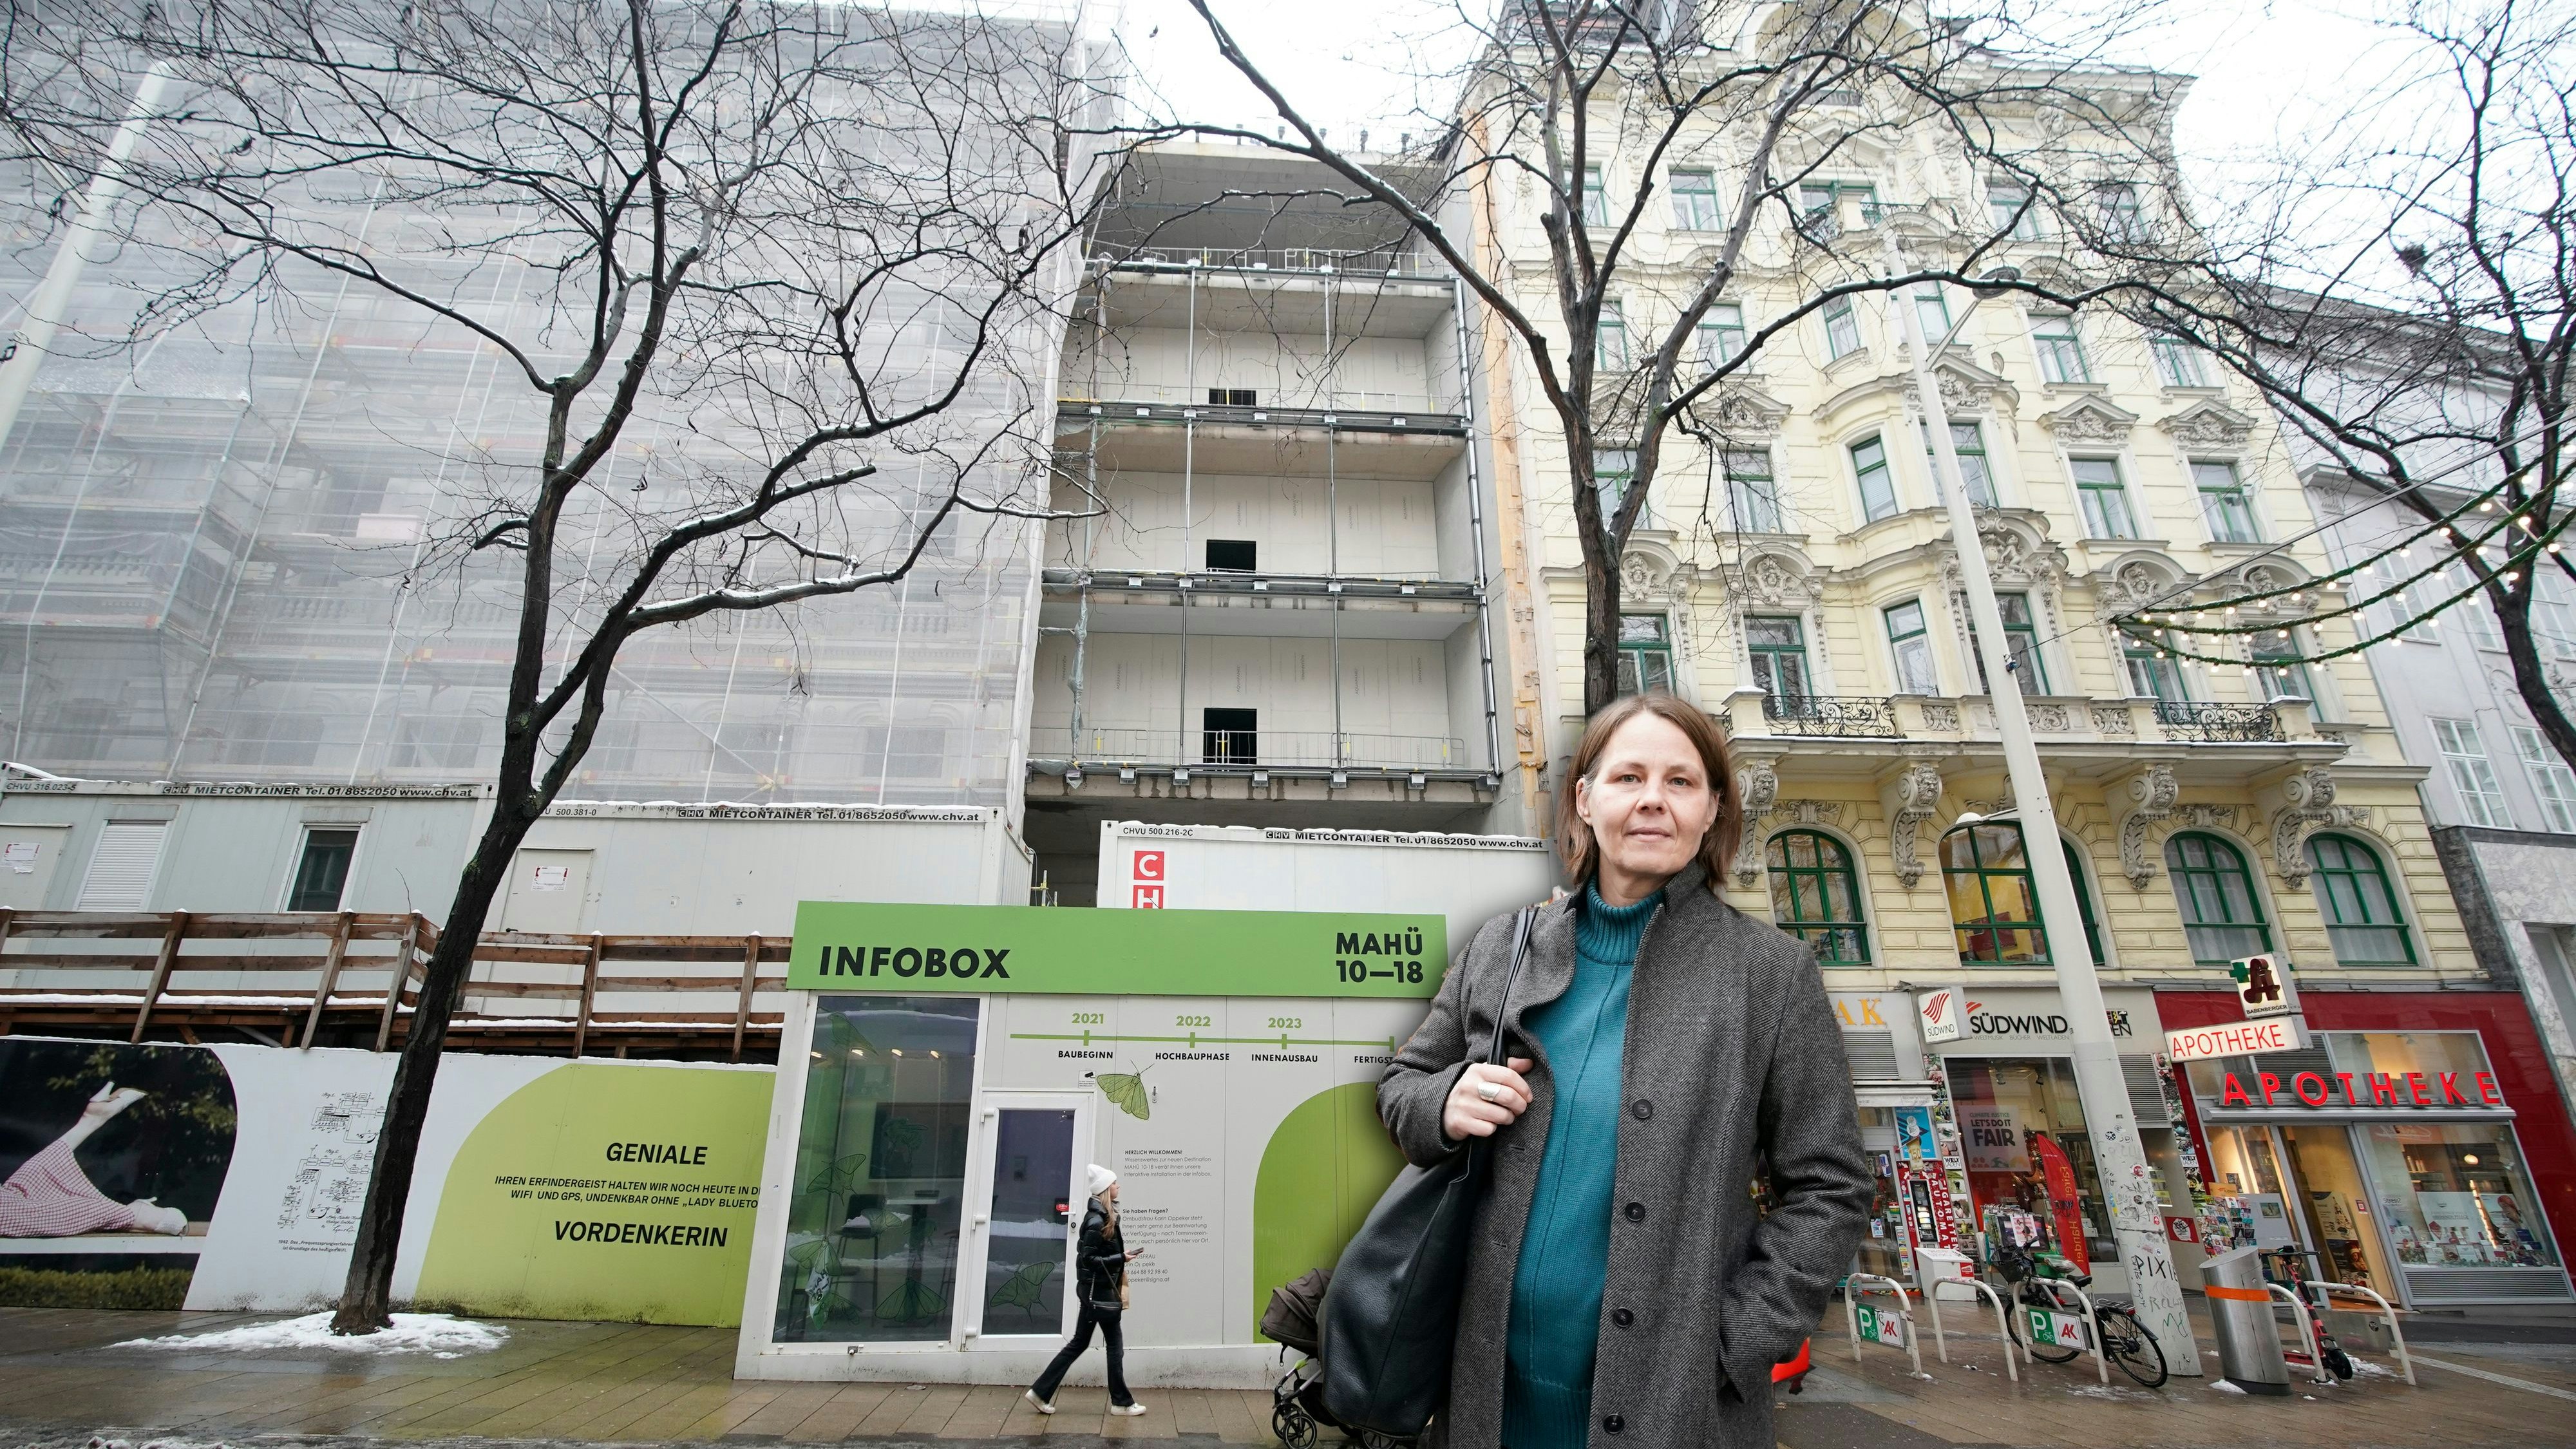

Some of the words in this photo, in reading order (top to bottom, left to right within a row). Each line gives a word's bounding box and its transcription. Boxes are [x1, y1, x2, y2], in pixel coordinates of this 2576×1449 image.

[194, 786, 300, 795] MIETCONTAINER
[305, 787, 325, 795] Tel.
[327, 787, 397, 796] 01/8652050
[399, 788, 473, 797] www.chv.at
[709, 810, 811, 819] MIETCONTAINER
[838, 811, 905, 820] 01/8652050
[908, 813, 978, 821] www.chv.at
[1148, 828, 1193, 837] 500.216-2C
[1295, 833, 1390, 843] MIETCONTAINER
[1415, 837, 1476, 846] 01/8652050
[1479, 839, 1542, 848] www.chv.at
[1336, 927, 1423, 956] MAHÜ
[819, 946, 1010, 978] INFOBOX
[2246, 1005, 2287, 1014] BABENBERGER
[1072, 1013, 1104, 1024] 2021
[1175, 1016, 1211, 1027] 2022
[1268, 1018, 1302, 1028] 2023
[1970, 1012, 2068, 1034] SÜDWIND
[1927, 1024, 1955, 1037] SÜDWIND
[2174, 1025, 2284, 1057] APOTHEKE
[1058, 1050, 1113, 1059] BAUBEGINN
[1252, 1054, 1318, 1063] INNENAUSBAU
[2223, 1072, 2501, 1106] APOTHEKE
[1973, 1128, 2016, 1146] FAIR
[606, 1142, 708, 1165] GENIALE
[495, 1176, 526, 1185] IHREN
[529, 1177, 607, 1189] ERFINDERGEIST
[608, 1181, 647, 1191] HALTEN
[649, 1182, 668, 1191] WIR
[670, 1184, 700, 1193] NOCH
[703, 1185, 735, 1194] HEUTE
[738, 1186, 749, 1195] IN
[511, 1190, 533, 1198] WIFI
[538, 1191, 559, 1200] UND
[561, 1192, 583, 1202] GPS,
[585, 1193, 649, 1204] UNDENKBAR
[650, 1196, 679, 1205] OHNE
[682, 1197, 715, 1208] „LADY
[555, 1220, 728, 1247] VORDENKERIN
[2069, 1221, 2083, 1262] Handel
[1859, 1307, 1873, 1336] P
[1883, 1320, 1898, 1338] AK
[2030, 1311, 2047, 1339] P
[2061, 1323, 2078, 1340] AK
